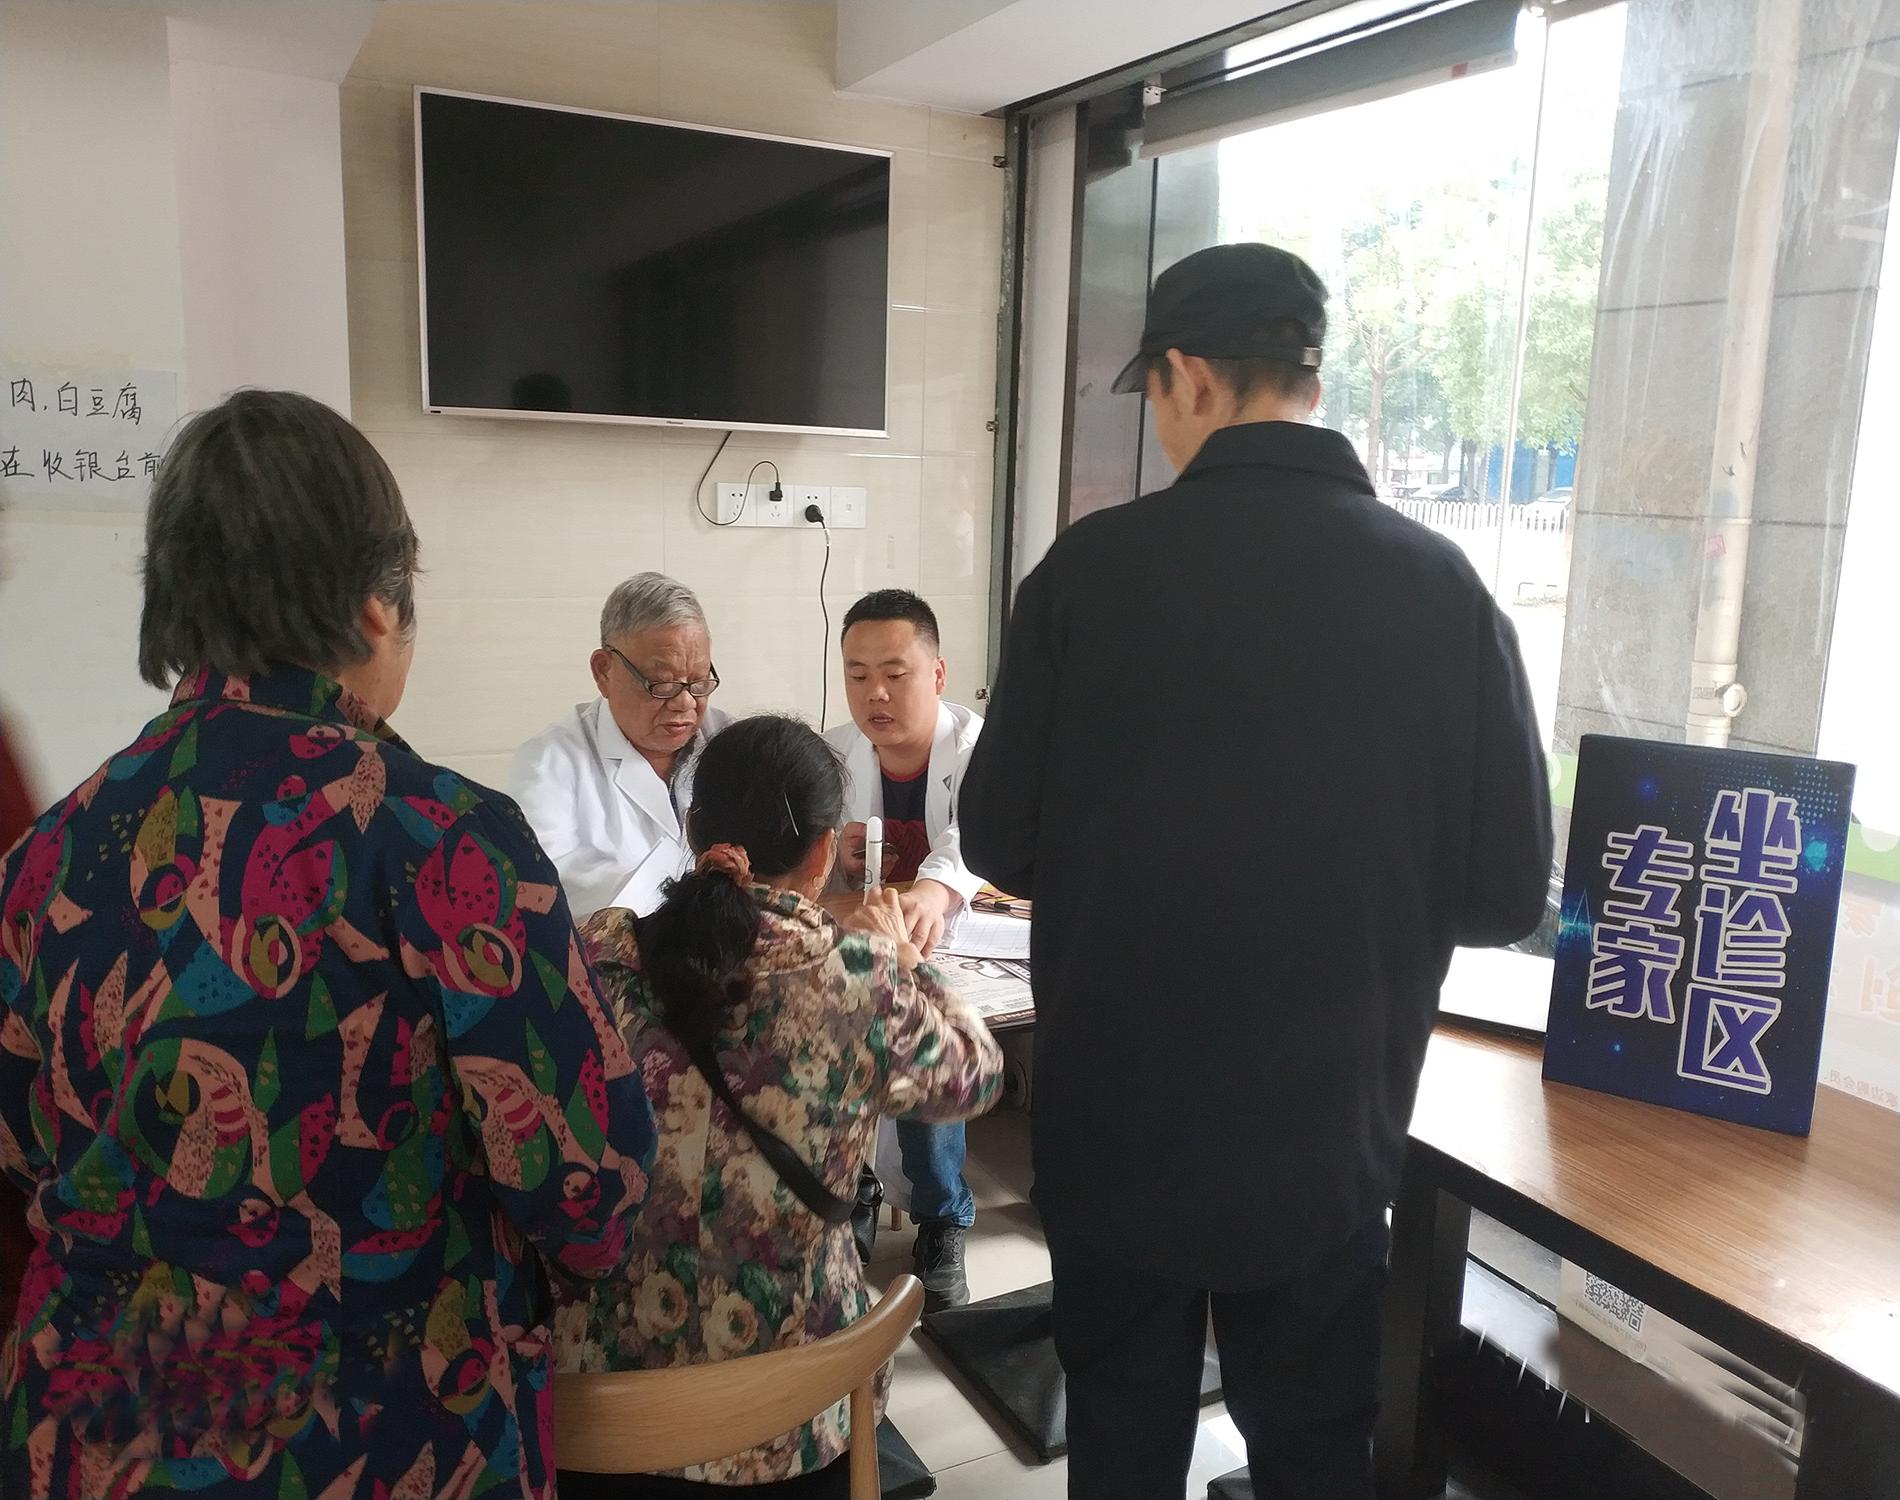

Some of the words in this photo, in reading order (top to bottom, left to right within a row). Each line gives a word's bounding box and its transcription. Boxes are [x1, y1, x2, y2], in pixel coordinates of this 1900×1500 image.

[1585, 824, 1694, 1025] 专家
[1676, 787, 1802, 1095] 坐诊区
